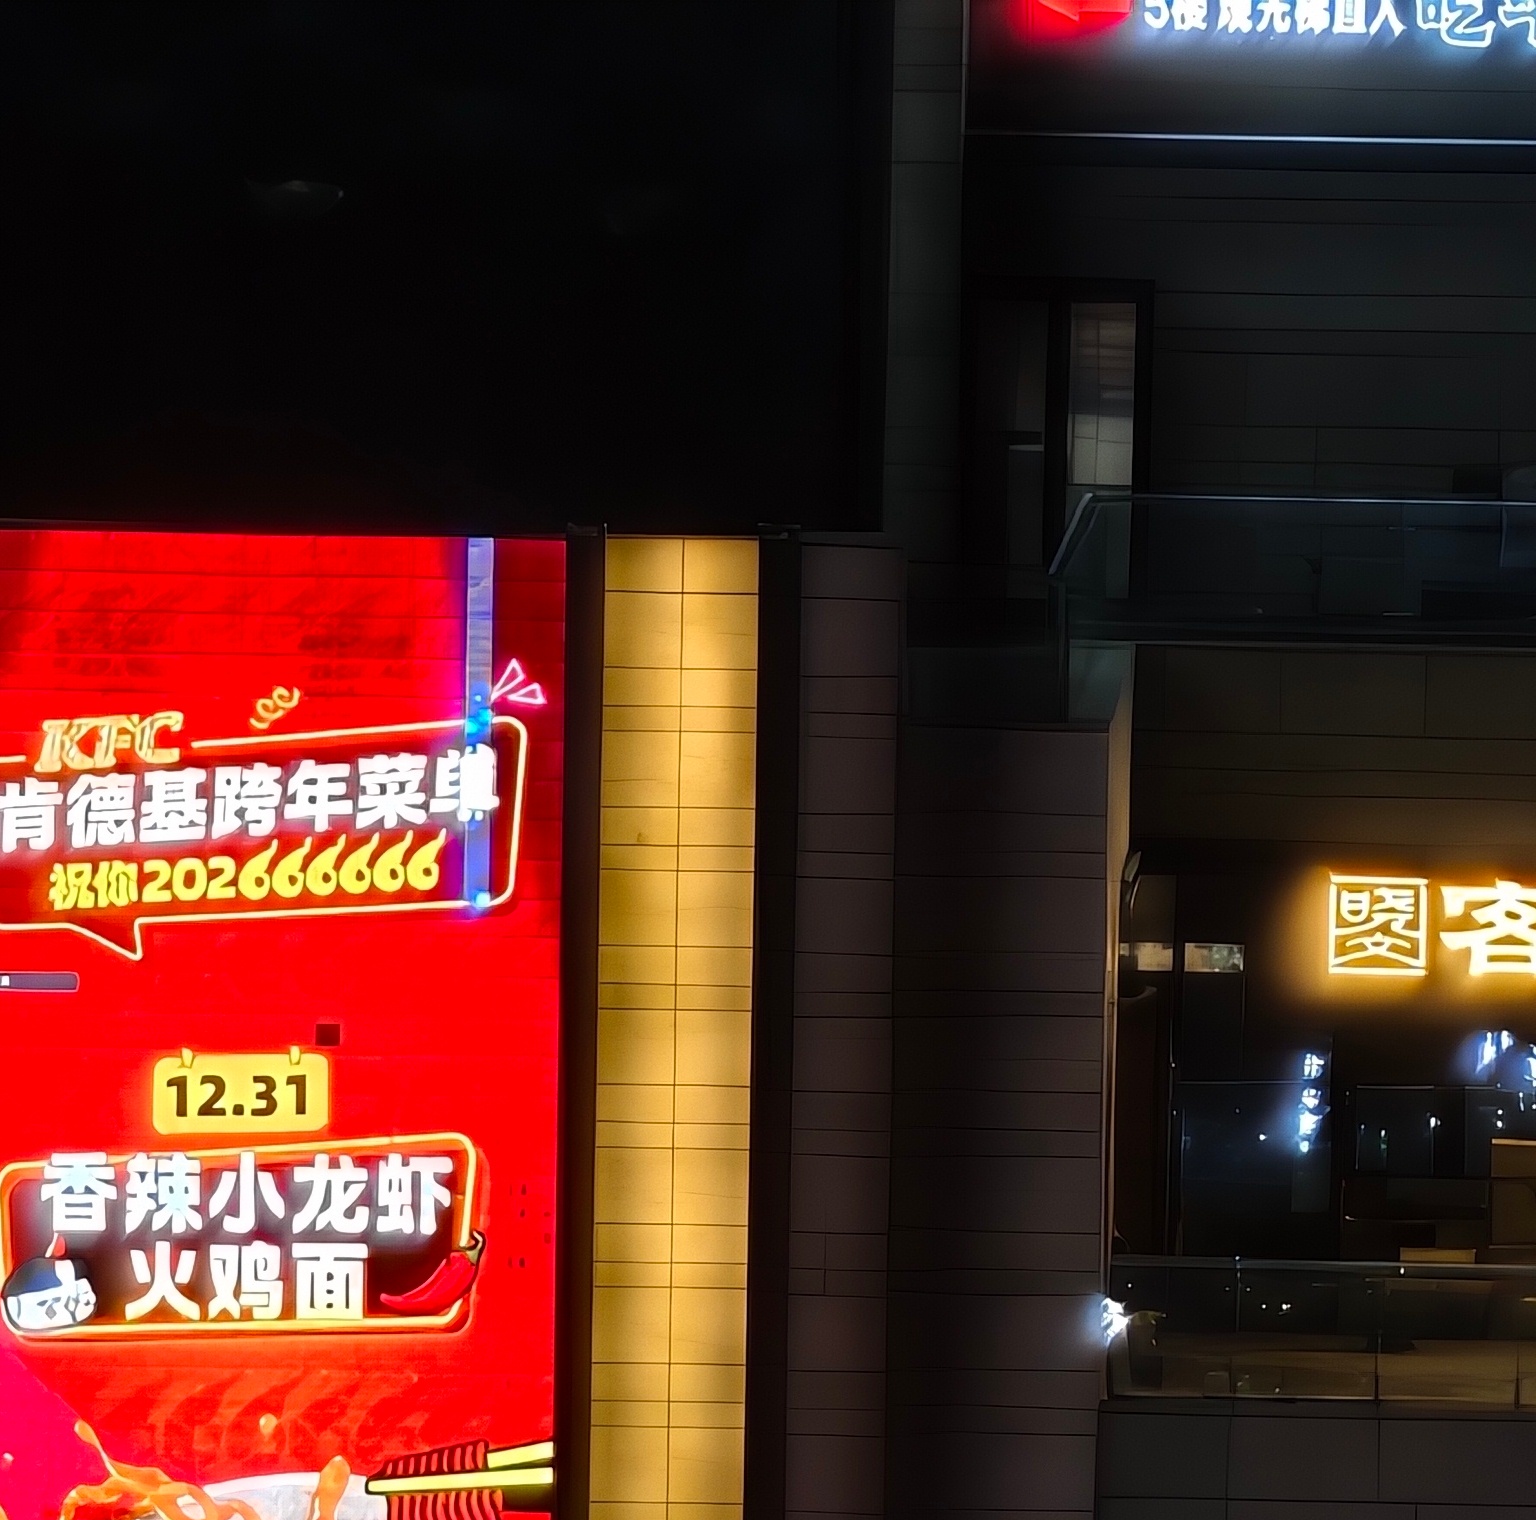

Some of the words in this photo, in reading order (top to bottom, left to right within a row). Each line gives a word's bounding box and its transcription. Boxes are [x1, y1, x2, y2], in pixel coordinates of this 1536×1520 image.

[34, 711, 185, 773] KFC
[166, 1074, 308, 1118] 12.31
[40, 1151, 454, 1236] 香辣小龙虾
[125, 1241, 369, 1321] 火鸡面
